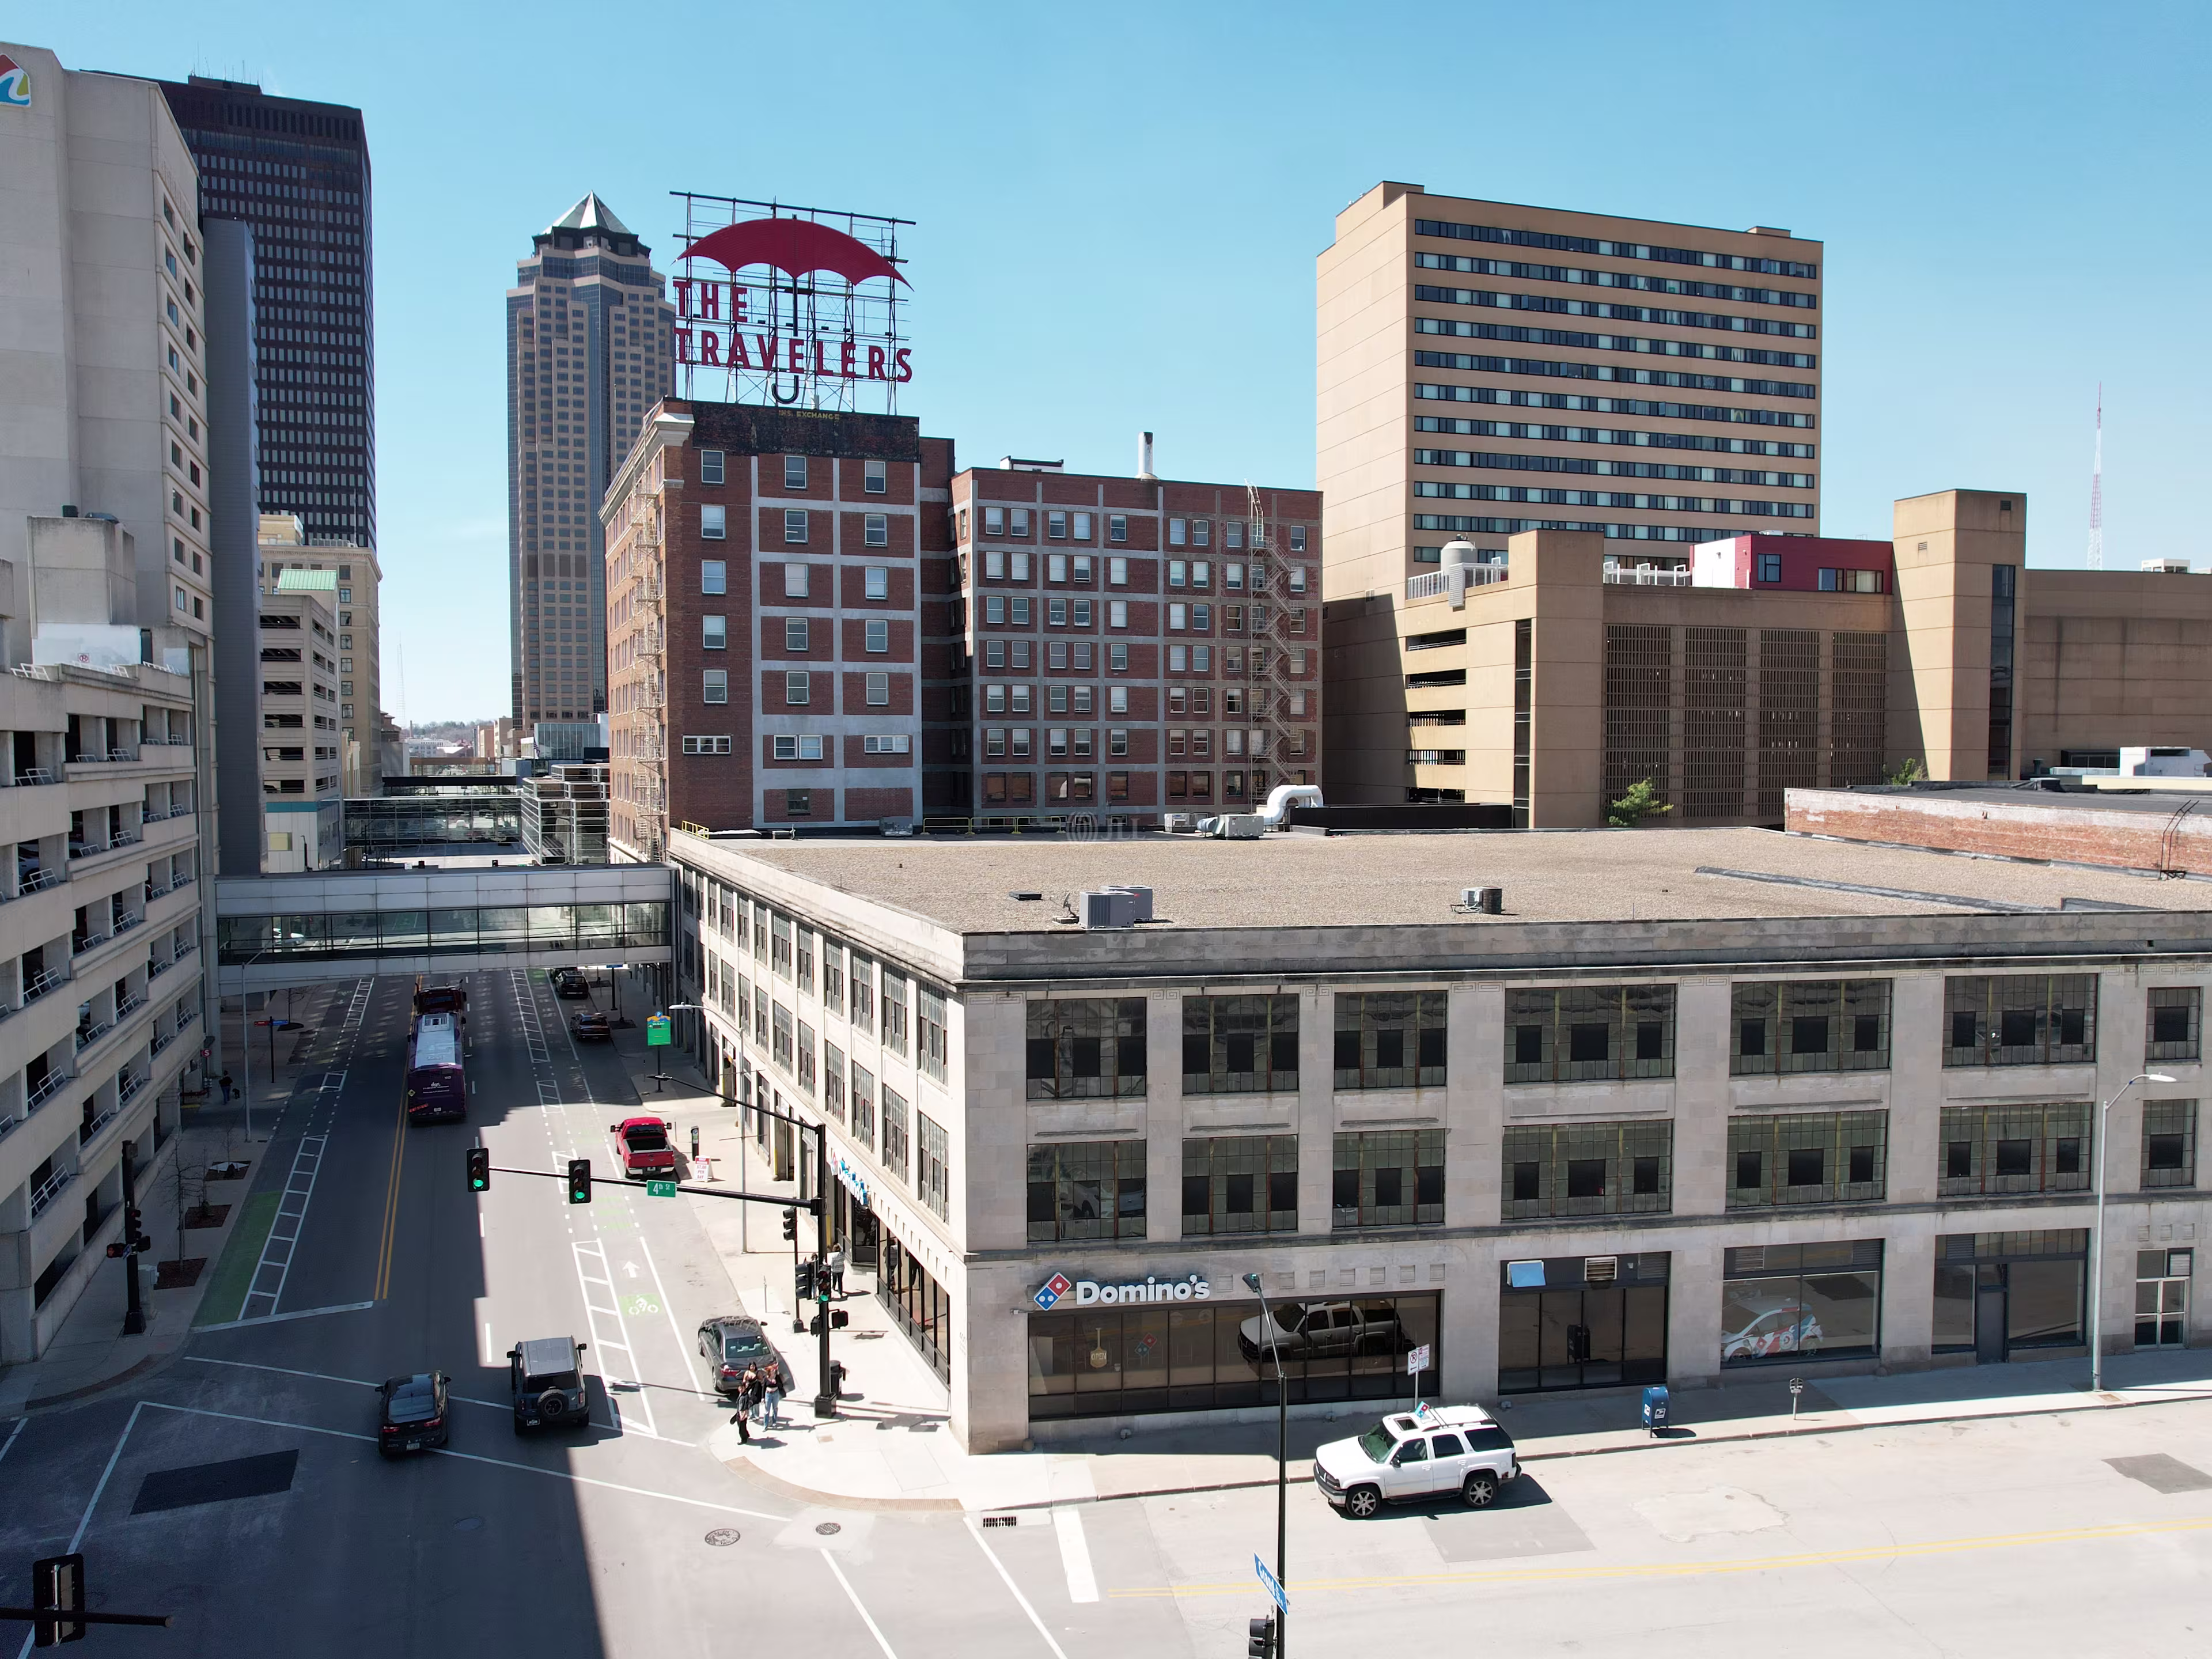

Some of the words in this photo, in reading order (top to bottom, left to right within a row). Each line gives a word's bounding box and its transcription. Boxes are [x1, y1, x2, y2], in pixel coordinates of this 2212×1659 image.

[673, 281, 748, 323] THE
[673, 327, 912, 382] TRAVELERS
[796, 411, 840, 420] EXCHANGE
[653, 1183, 664, 1195] 4th
[1076, 1274, 1210, 1305] Domino's
[1091, 1352, 1107, 1360] OPEN
